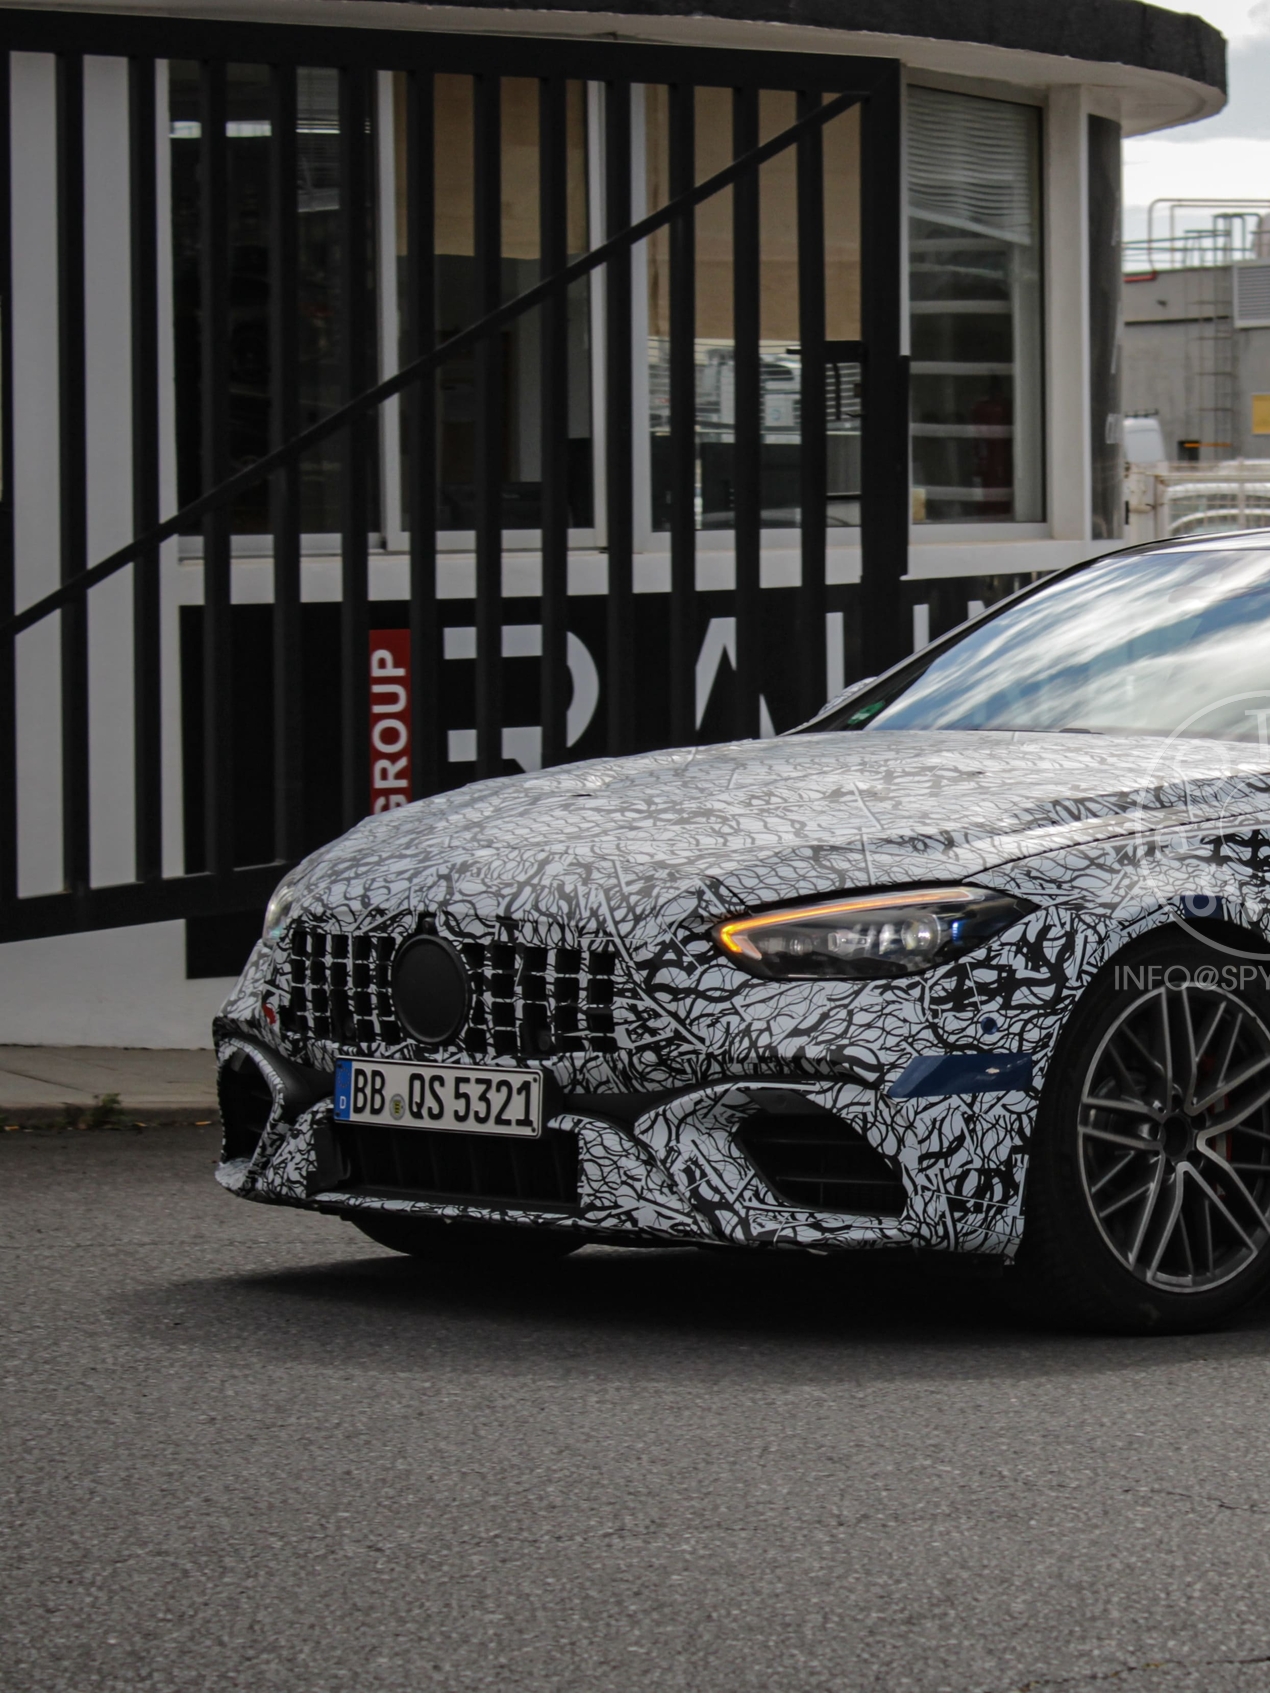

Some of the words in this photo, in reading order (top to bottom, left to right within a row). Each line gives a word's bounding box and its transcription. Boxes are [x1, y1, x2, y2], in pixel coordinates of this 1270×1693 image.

[339, 1096, 347, 1109] D
[353, 1068, 386, 1115] BB
[408, 1072, 445, 1121] QS
[453, 1076, 534, 1127] 5321
